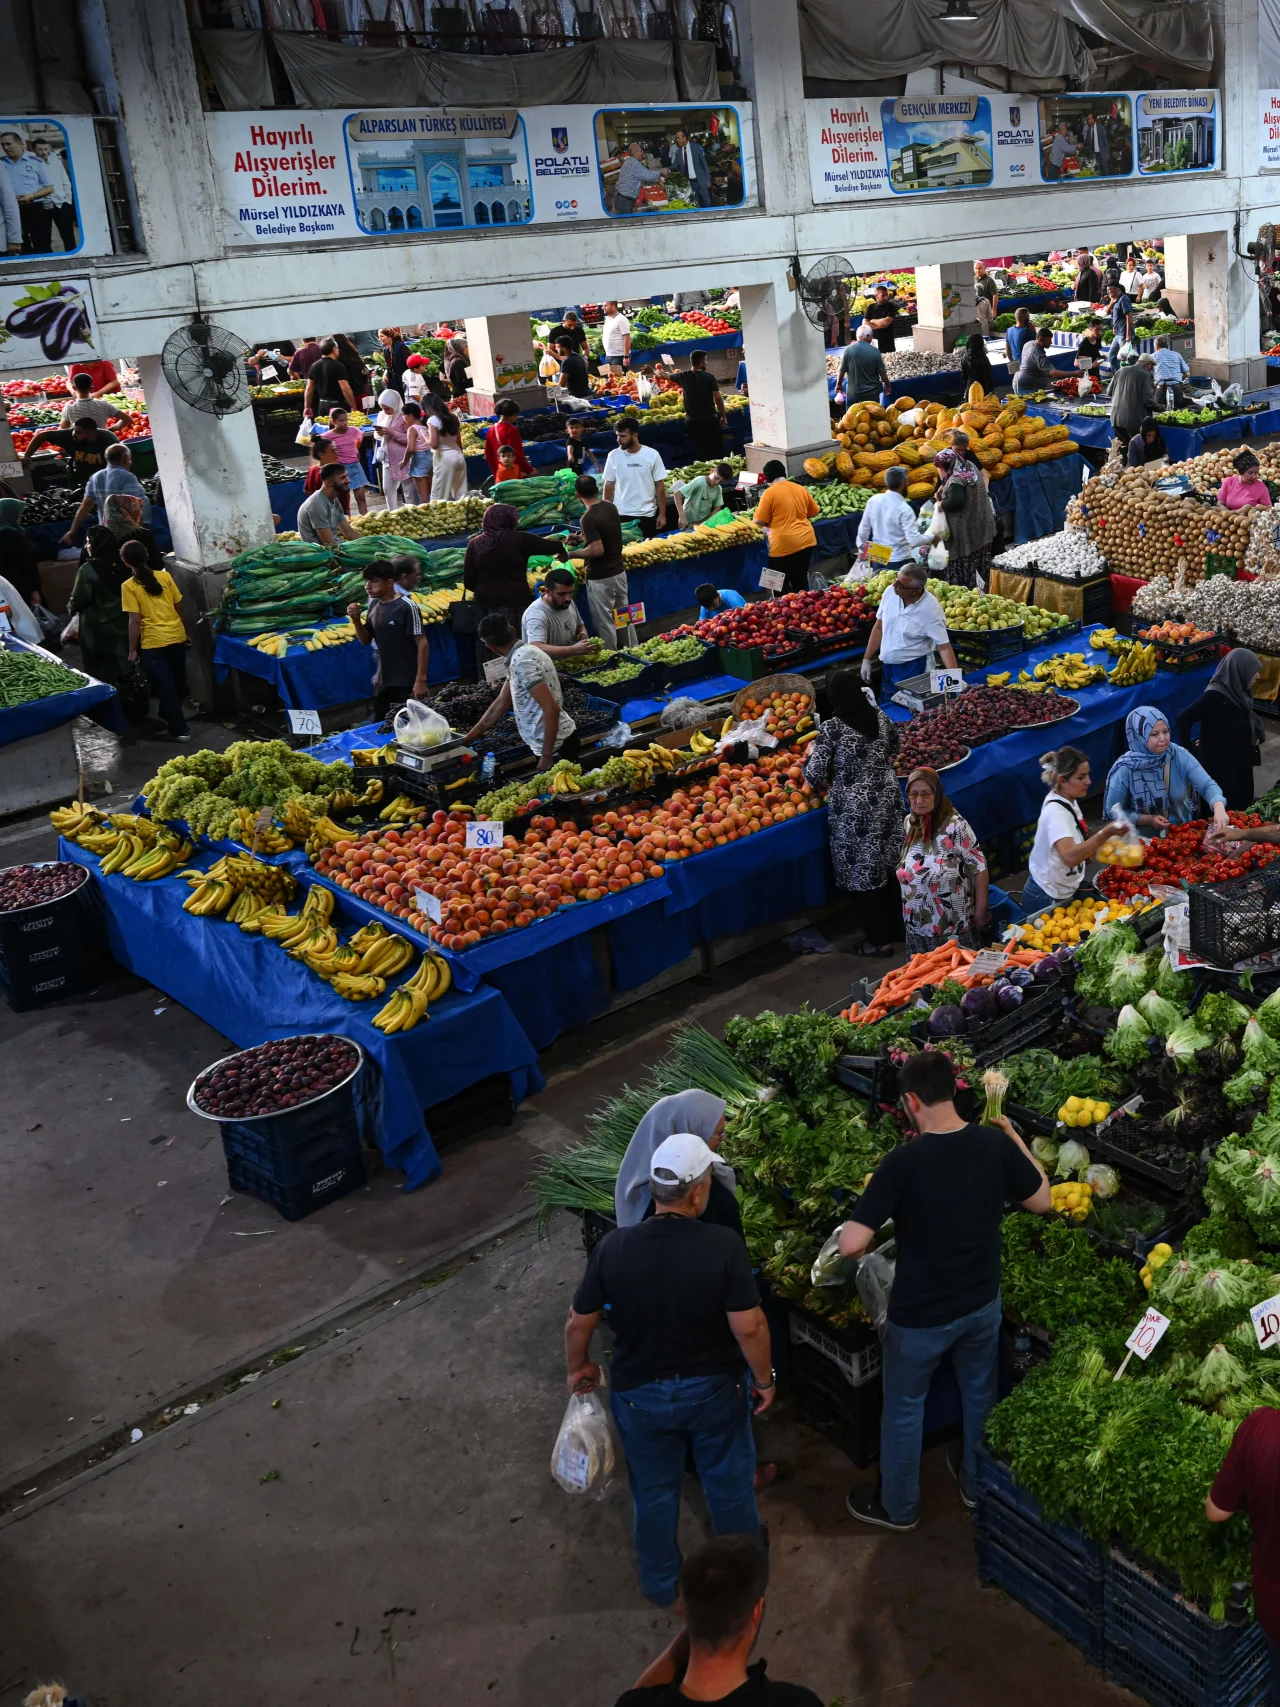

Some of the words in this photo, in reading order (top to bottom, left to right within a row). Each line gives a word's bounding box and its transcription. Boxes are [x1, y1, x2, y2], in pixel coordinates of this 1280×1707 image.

[901, 100, 937, 119] GENÇLİK
[938, 99, 971, 115] MERKEZİ
[1148, 96, 1163, 109] YENİ
[1163, 95, 1187, 108] BELEDİYE
[1188, 94, 1208, 107] BİNASI
[359, 119, 416, 133] ALPARSLAN
[418, 115, 456, 135] TÜRKEŞ
[459, 113, 507, 132] KÜLLİYESİ
[830, 106, 869, 127] Hayırlı
[250, 123, 313, 150] Hayırlı
[821, 126, 884, 148] Alışverişler
[997, 130, 1034, 140] POLATLI
[234, 149, 336, 177] Alışverişler
[534, 156, 589, 167] POLATLI
[832, 147, 878, 164] Dilerim.
[824, 171, 849, 182] Mürsel
[850, 168, 888, 180] YILDIZKAYA
[252, 176, 327, 198] Dilerim.
[239, 206, 279, 221] Mürsel
[281, 204, 345, 219] YILDIZKAYA
[1, 464, 15, 477] 25
[295, 718, 314, 732] 70
[476, 828, 494, 846] 80
[1130, 1323, 1156, 1348] 10
[1260, 1313, 1280, 1344] 10
